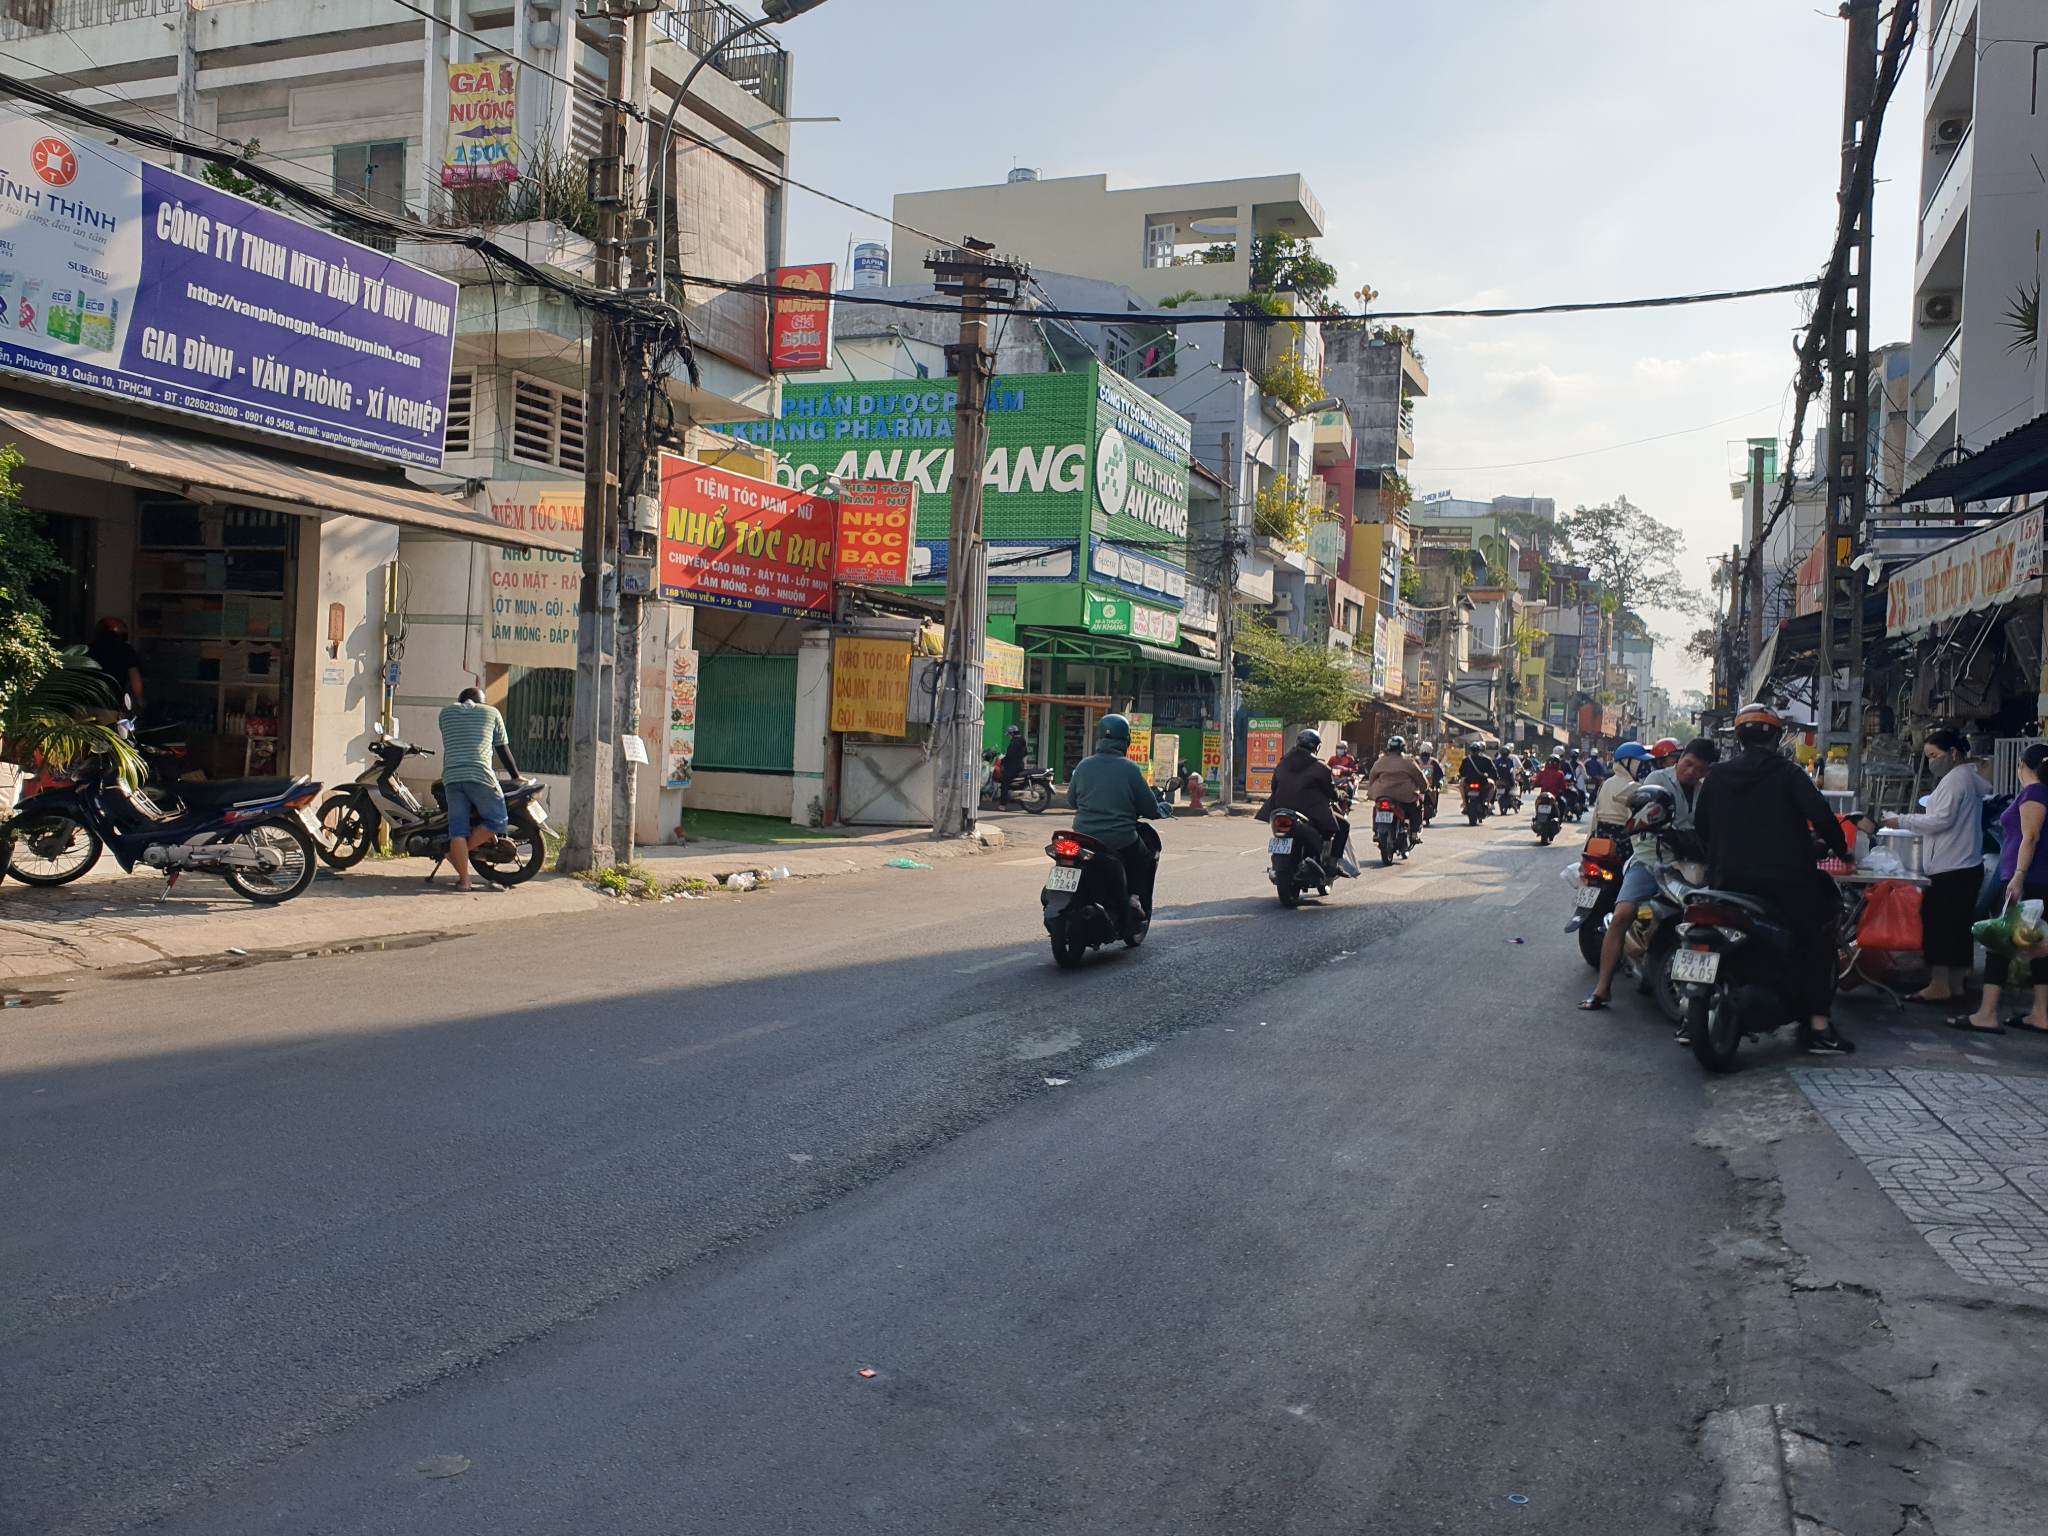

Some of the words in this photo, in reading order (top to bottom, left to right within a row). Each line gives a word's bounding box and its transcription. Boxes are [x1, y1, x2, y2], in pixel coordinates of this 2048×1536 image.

[450, 67, 495, 92] GÀ
[47, 193, 116, 232] THỊNH
[67, 261, 109, 281] SUBARU
[157, 201, 210, 254] CÔNG
[215, 221, 238, 262] TY
[241, 231, 287, 280] TNHH
[289, 250, 327, 293] MTV
[327, 257, 360, 305] ĐẦU
[363, 276, 385, 313] TƯ
[384, 285, 413, 323] HUY
[414, 296, 450, 337] MINH
[186, 282, 421, 368] http://vanphongphamhuyminh.com
[141, 327, 177, 367] GIA
[183, 334, 235, 380] ĐÌNH
[252, 356, 293, 395] VĂN
[293, 370, 352, 412] PHÒNG
[366, 386, 385, 420] XÍ
[386, 395, 441, 437] NGHIỆP
[16, 354, 59, 377] Phường
[61, 365, 70, 379] 9,
[72, 368, 99, 386] Quận
[102, 375, 115, 390] 10,
[117, 378, 152, 397] TPHCM
[184, 396, 238, 417] 02862933008
[244, 411, 263, 424] 0901
[265, 414, 275, 426] 49
[297, 424, 320, 438] email:
[321, 430, 440, 465] vanphongphamhuyminh@gmail.com
[859, 391, 939, 418] DƯỢC
[1099, 385, 1120, 410] CÔNG
[1120, 398, 1131, 416] TY
[732, 421, 827, 442] KHANG
[834, 417, 956, 439] PHARMA
[881, 482, 910, 495] TÓC
[1134, 459, 1153, 490] NHÀ
[1153, 469, 1184, 502] THUỐC
[695, 477, 729, 500] TIỆM
[732, 484, 758, 508] TÓC
[761, 494, 787, 515] NAM
[797, 503, 814, 521] NỮ
[843, 495, 875, 505] NAM
[1125, 485, 1146, 520] AN
[1145, 491, 1188, 538] KHANG
[491, 498, 525, 530] TIỆM
[529, 497, 556, 531] TÓC
[666, 503, 728, 550] NHỔ
[734, 520, 781, 560] TÓC
[786, 533, 831, 573] BẠC
[843, 528, 903, 547] TÓC
[668, 551, 710, 570] CHUYÊN:
[712, 559, 730, 574] CẠO
[732, 562, 750, 578] MẶT
[758, 566, 776, 581] RÁY
[777, 572, 790, 585] TAI
[796, 574, 811, 589] LỘT
[841, 549, 901, 568] BẠC
[492, 570, 519, 590] CẠO
[522, 570, 549, 592] MẶT
[697, 573, 718, 590] LÀM
[720, 577, 748, 594] MÓNG
[754, 584, 770, 599] GỘI
[776, 587, 806, 603] NHUỘM
[514, 599, 537, 620] MỤN
[545, 597, 563, 620] GỘI
[680, 589, 698, 601] VĨNH
[700, 591, 716, 604] VIỄN
[514, 622, 541, 642] MÓNG
[863, 648, 882, 669] TÓC
